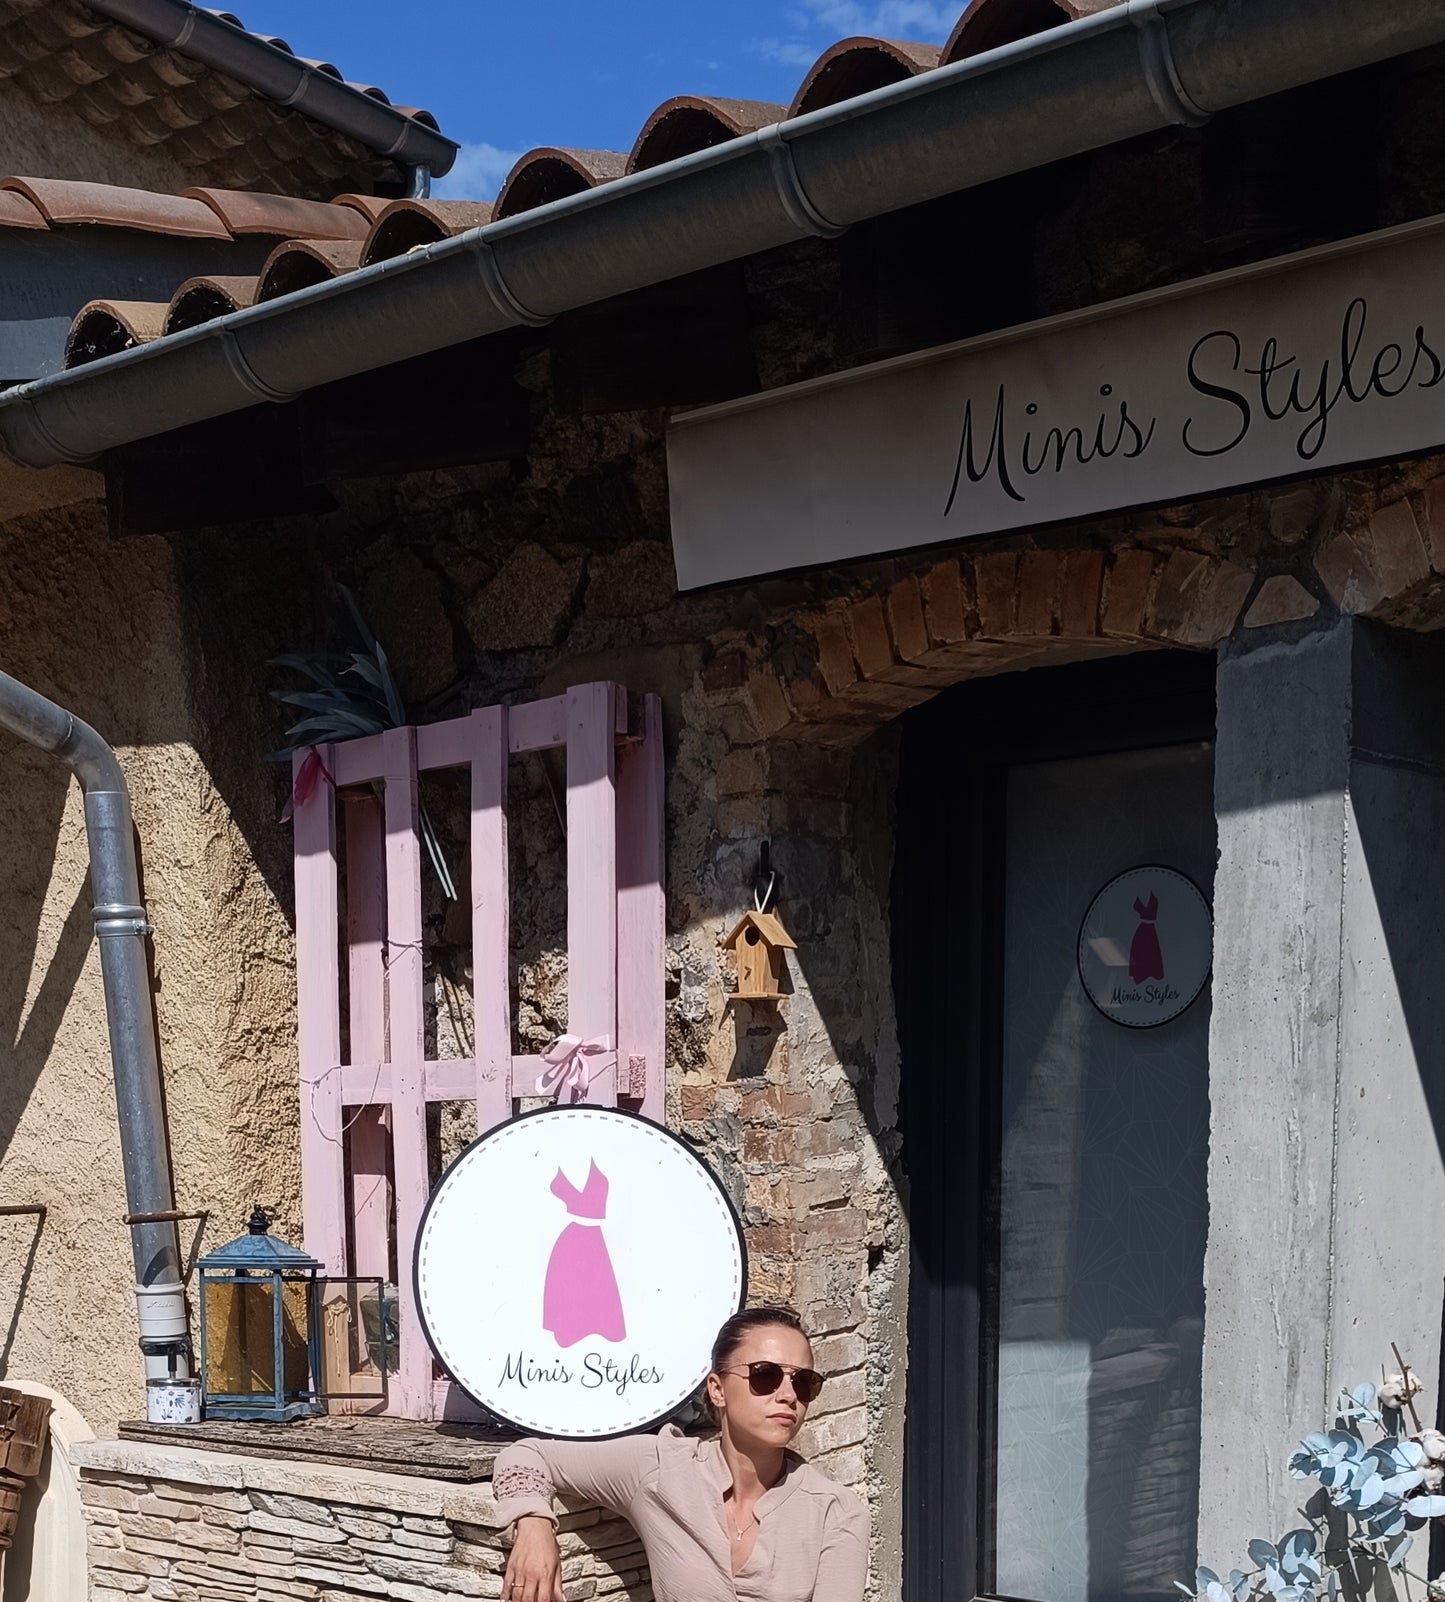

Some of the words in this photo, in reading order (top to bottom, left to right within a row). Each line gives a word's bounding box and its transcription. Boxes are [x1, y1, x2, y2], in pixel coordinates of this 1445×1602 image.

[944, 383, 1156, 517] Minis
[1182, 297, 1445, 460] Styles
[1111, 986, 1142, 1006] Minis
[1143, 984, 1180, 1006] Styles
[498, 1351, 573, 1389] Minis
[580, 1353, 664, 1396] Styles
